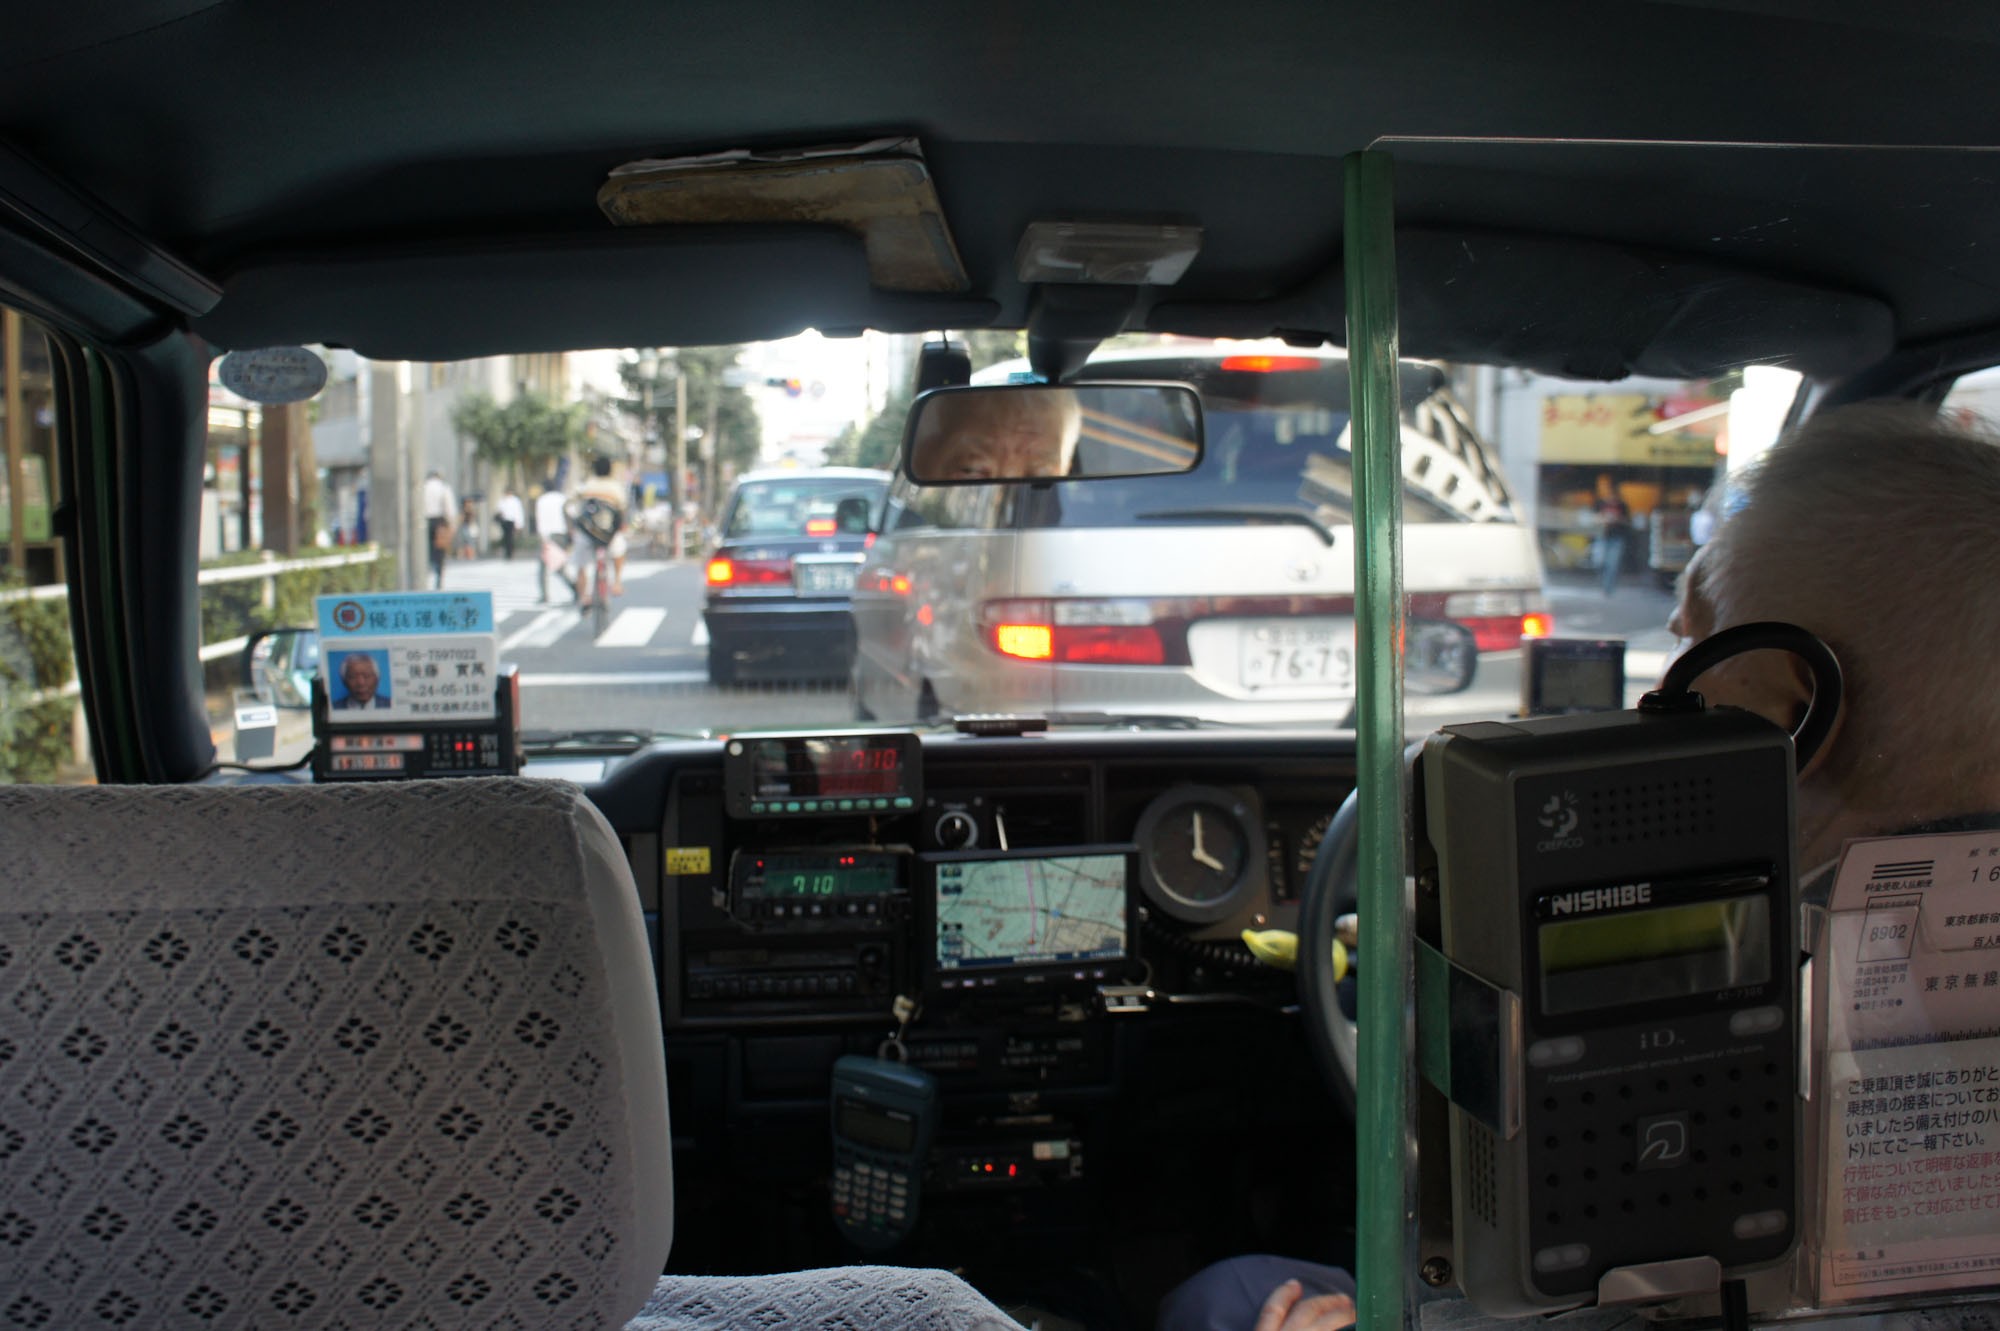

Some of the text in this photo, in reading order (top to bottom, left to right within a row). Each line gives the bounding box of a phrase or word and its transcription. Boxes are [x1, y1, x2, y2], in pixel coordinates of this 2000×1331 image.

[1267, 647, 1351, 679] 76-79
[793, 874, 835, 895] 710
[1551, 883, 1651, 916] NISHIBE
[1871, 925, 1908, 942] 8902
